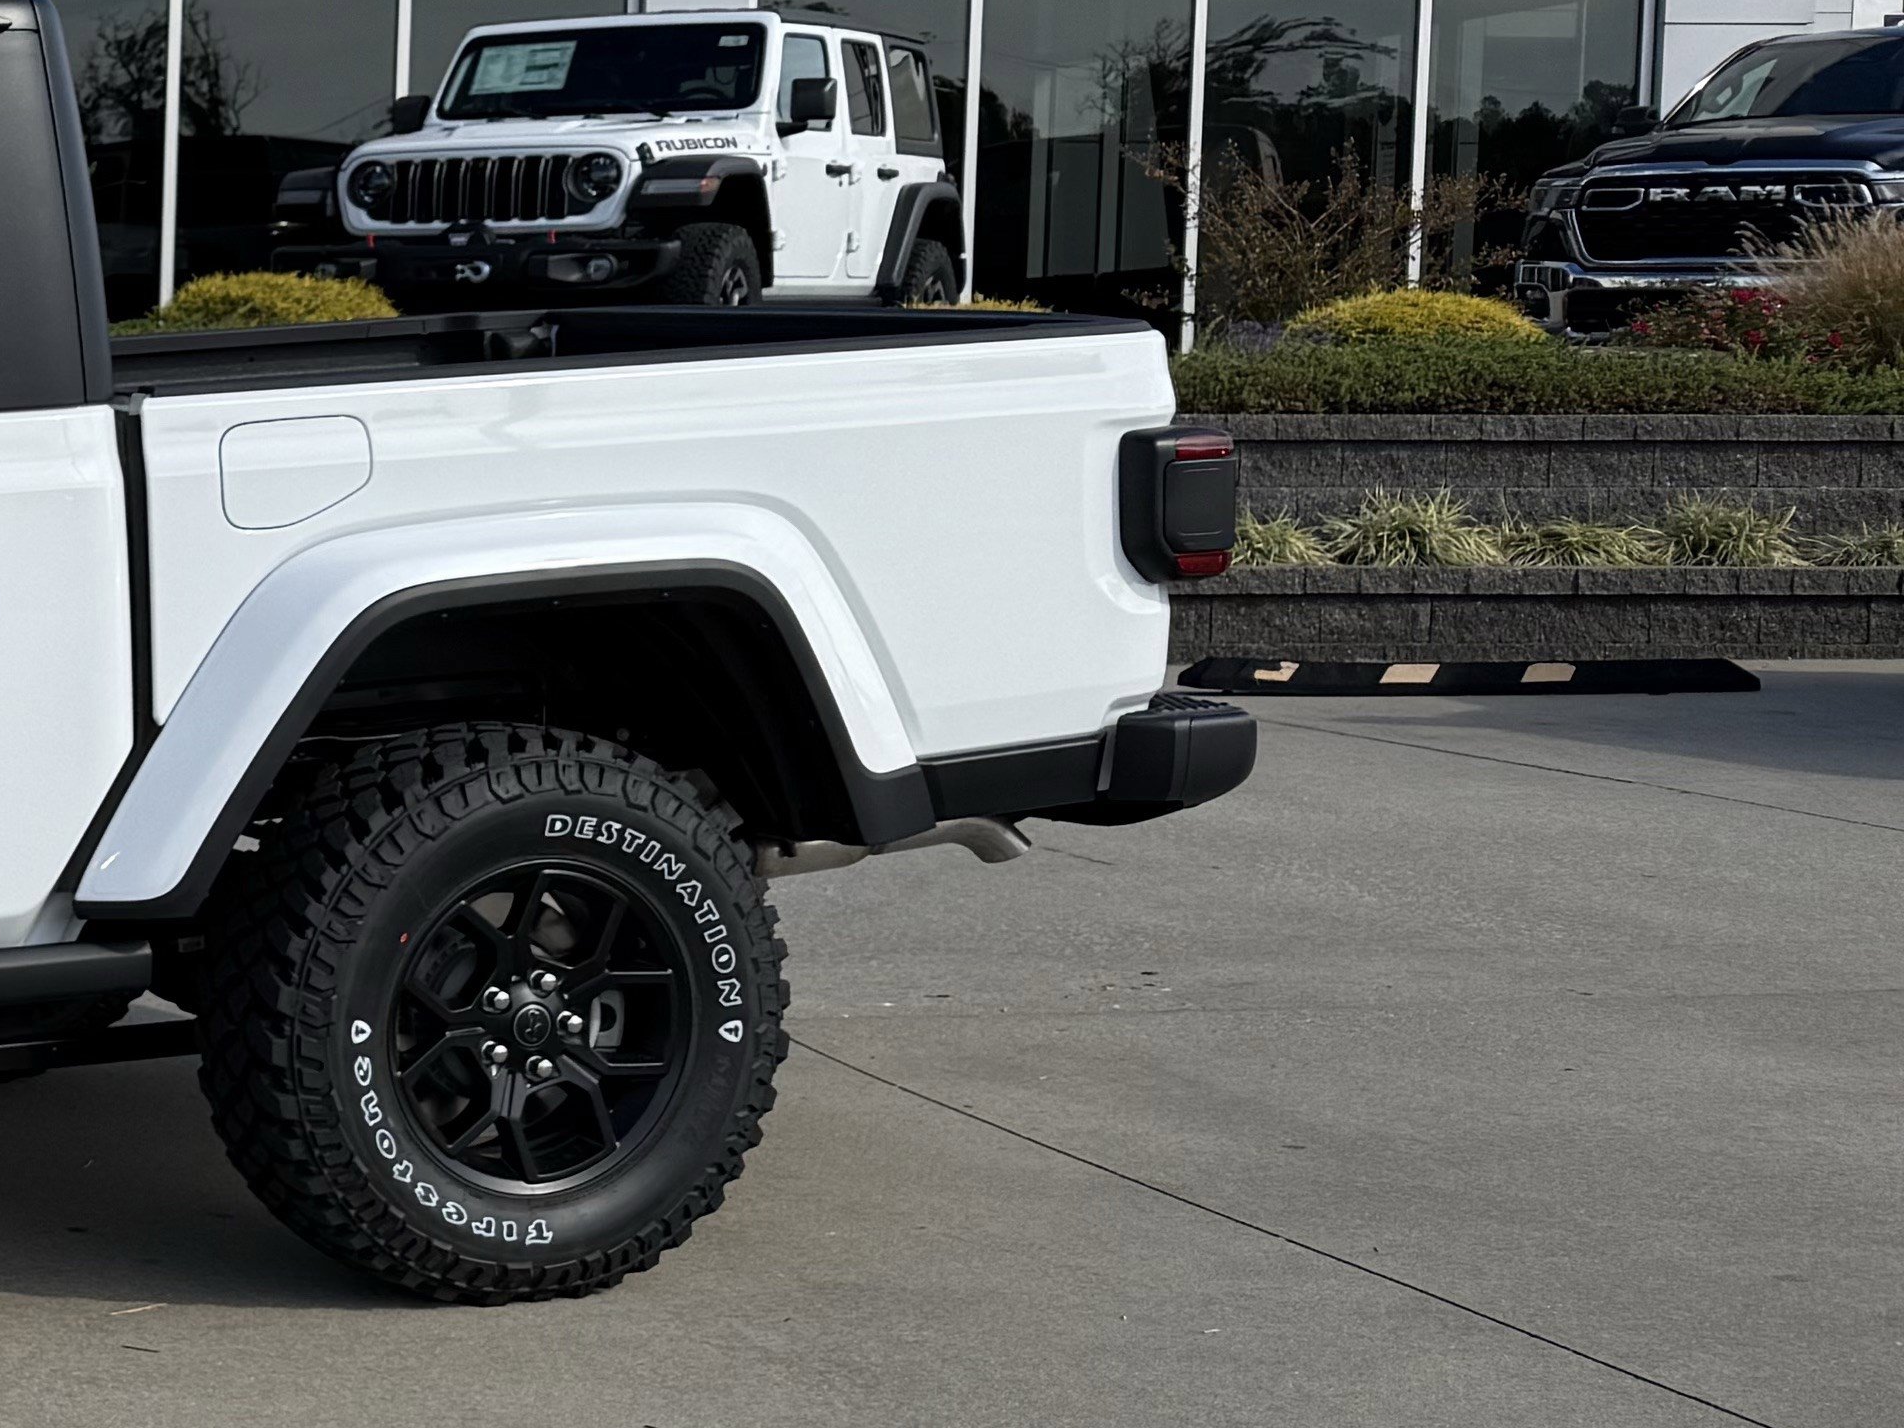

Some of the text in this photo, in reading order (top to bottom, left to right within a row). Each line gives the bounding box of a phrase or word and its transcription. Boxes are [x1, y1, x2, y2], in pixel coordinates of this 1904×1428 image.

[655, 137, 738, 152] RUBICON
[1649, 185, 1786, 202] RAM
[544, 814, 743, 1007] DESTINATION
